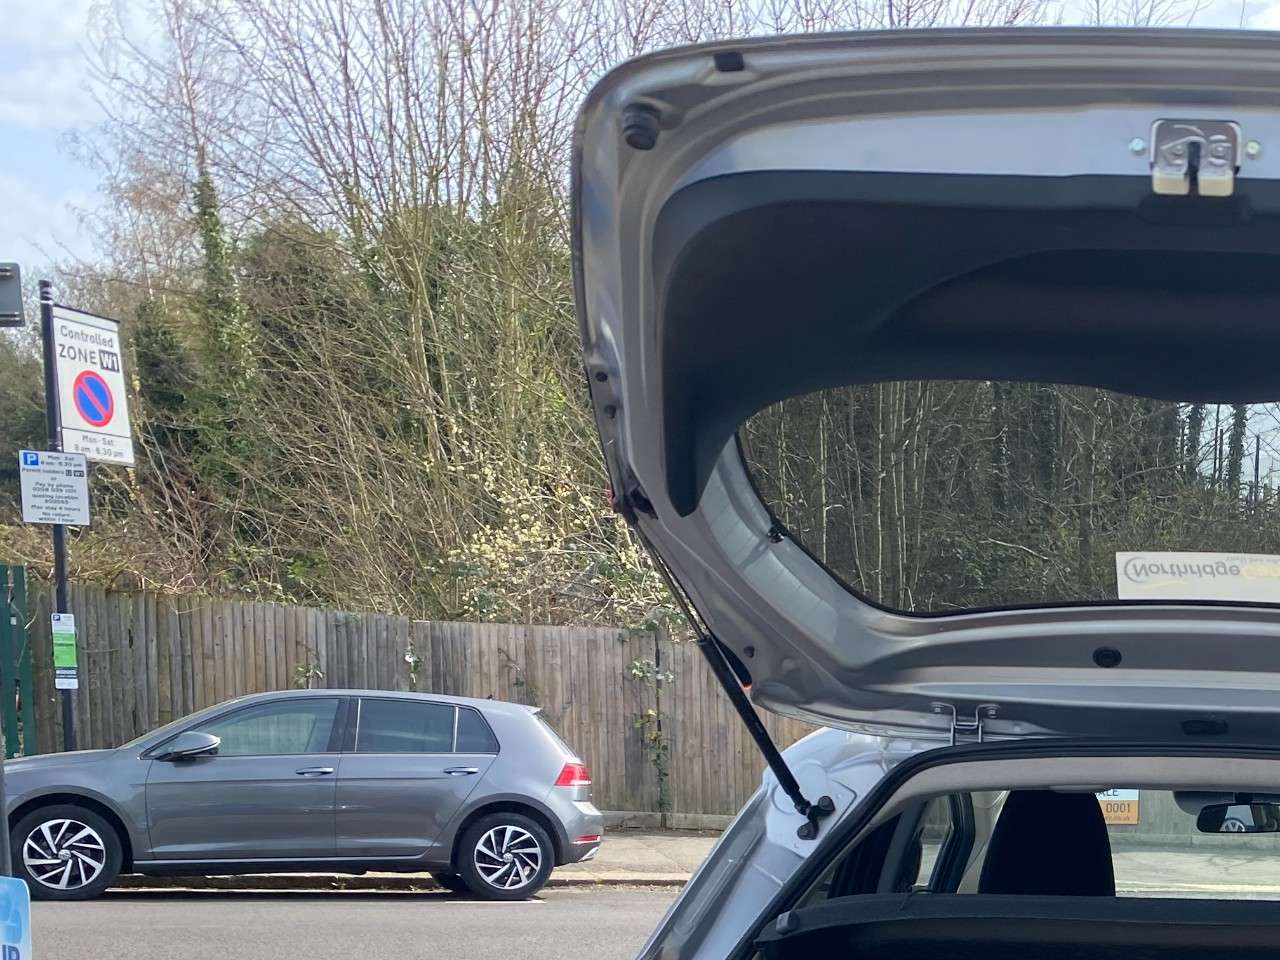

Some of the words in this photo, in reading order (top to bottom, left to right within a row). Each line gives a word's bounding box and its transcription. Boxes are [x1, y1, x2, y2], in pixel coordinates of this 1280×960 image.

[60, 325, 113, 348] Controlled
[59, 344, 97, 364] ZONE
[100, 353, 118, 371] W1
[26, 454, 37, 464] P
